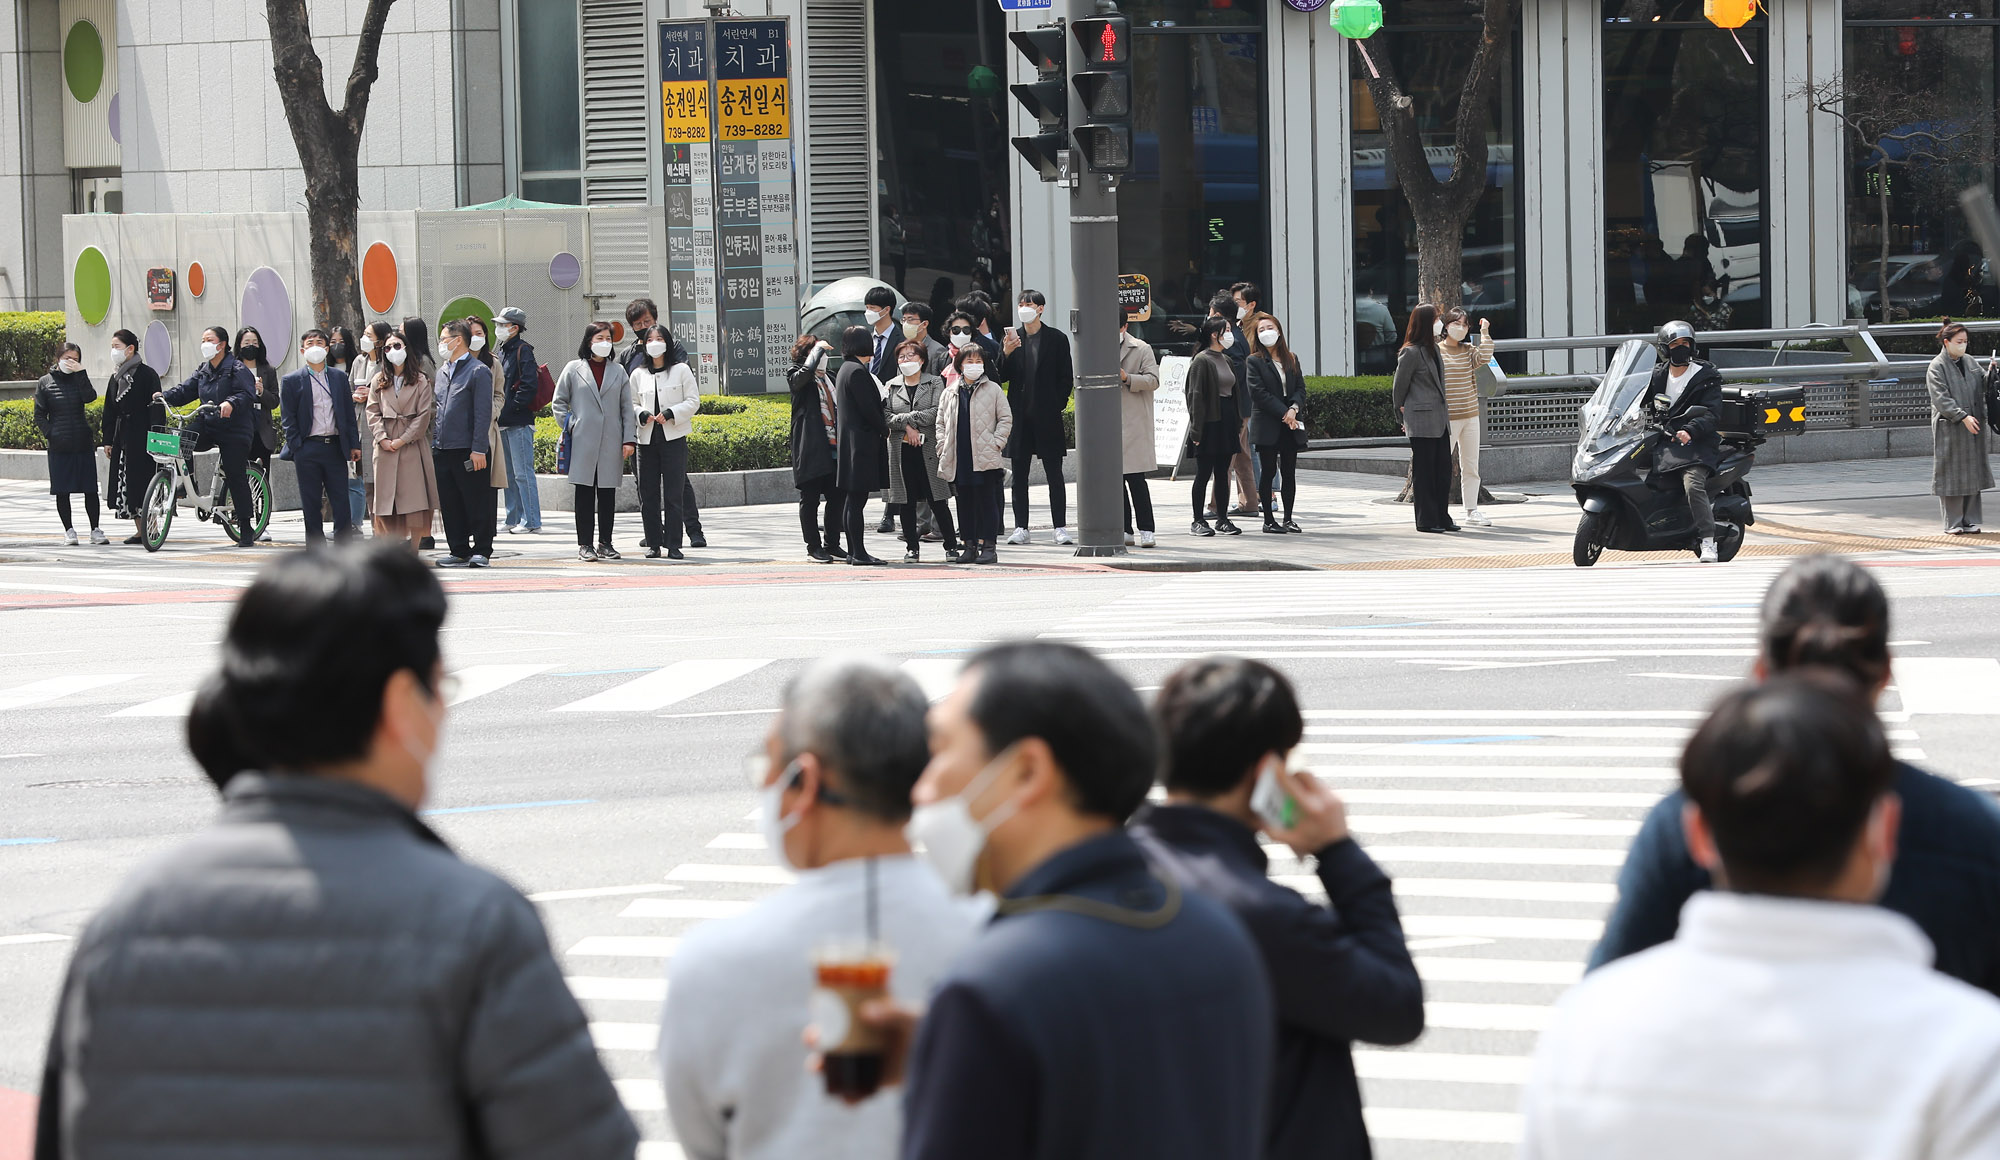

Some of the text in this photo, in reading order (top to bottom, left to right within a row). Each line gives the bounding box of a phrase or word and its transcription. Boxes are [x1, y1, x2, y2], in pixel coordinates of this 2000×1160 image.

[722, 28, 779, 40] 서린연세 B1
[665, 87, 707, 119] 송전일식
[720, 84, 785, 117] 송전일식
[668, 126, 706, 139] 739-8282
[724, 124, 783, 137] 739-8282
[761, 151, 787, 161] 닭한마리
[666, 163, 690, 177] 에스테틱
[722, 154, 757, 175] 삼계탕
[761, 161, 788, 171] 닭도리탕
[723, 196, 759, 218] 두부촌
[669, 236, 693, 252] 엔피스
[725, 234, 759, 257] 안동국시
[727, 277, 760, 300] 동경암
[767, 323, 786, 333] 한정식
[767, 333, 794, 344] 간장게장
[729, 367, 765, 377] 722-9462
